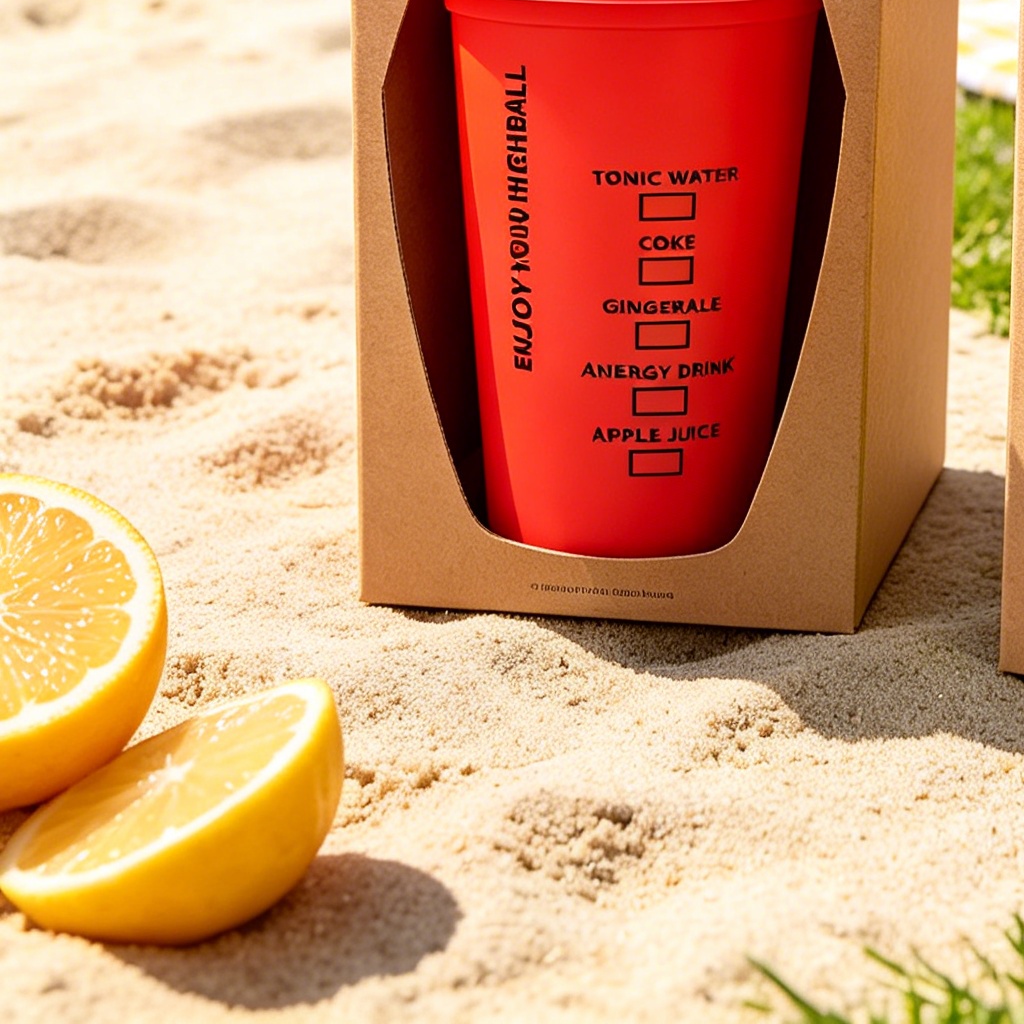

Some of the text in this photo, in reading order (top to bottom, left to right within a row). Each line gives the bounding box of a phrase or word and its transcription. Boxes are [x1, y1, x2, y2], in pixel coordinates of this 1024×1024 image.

[592, 167, 739, 186] TONIC WATER
[638, 235, 696, 251] COKE
[602, 297, 722, 315] GINGERALE
[511, 275, 533, 372] ENJOY
[581, 356, 735, 381] ANERGY DRINK
[592, 423, 720, 443] APPLE JUICE
